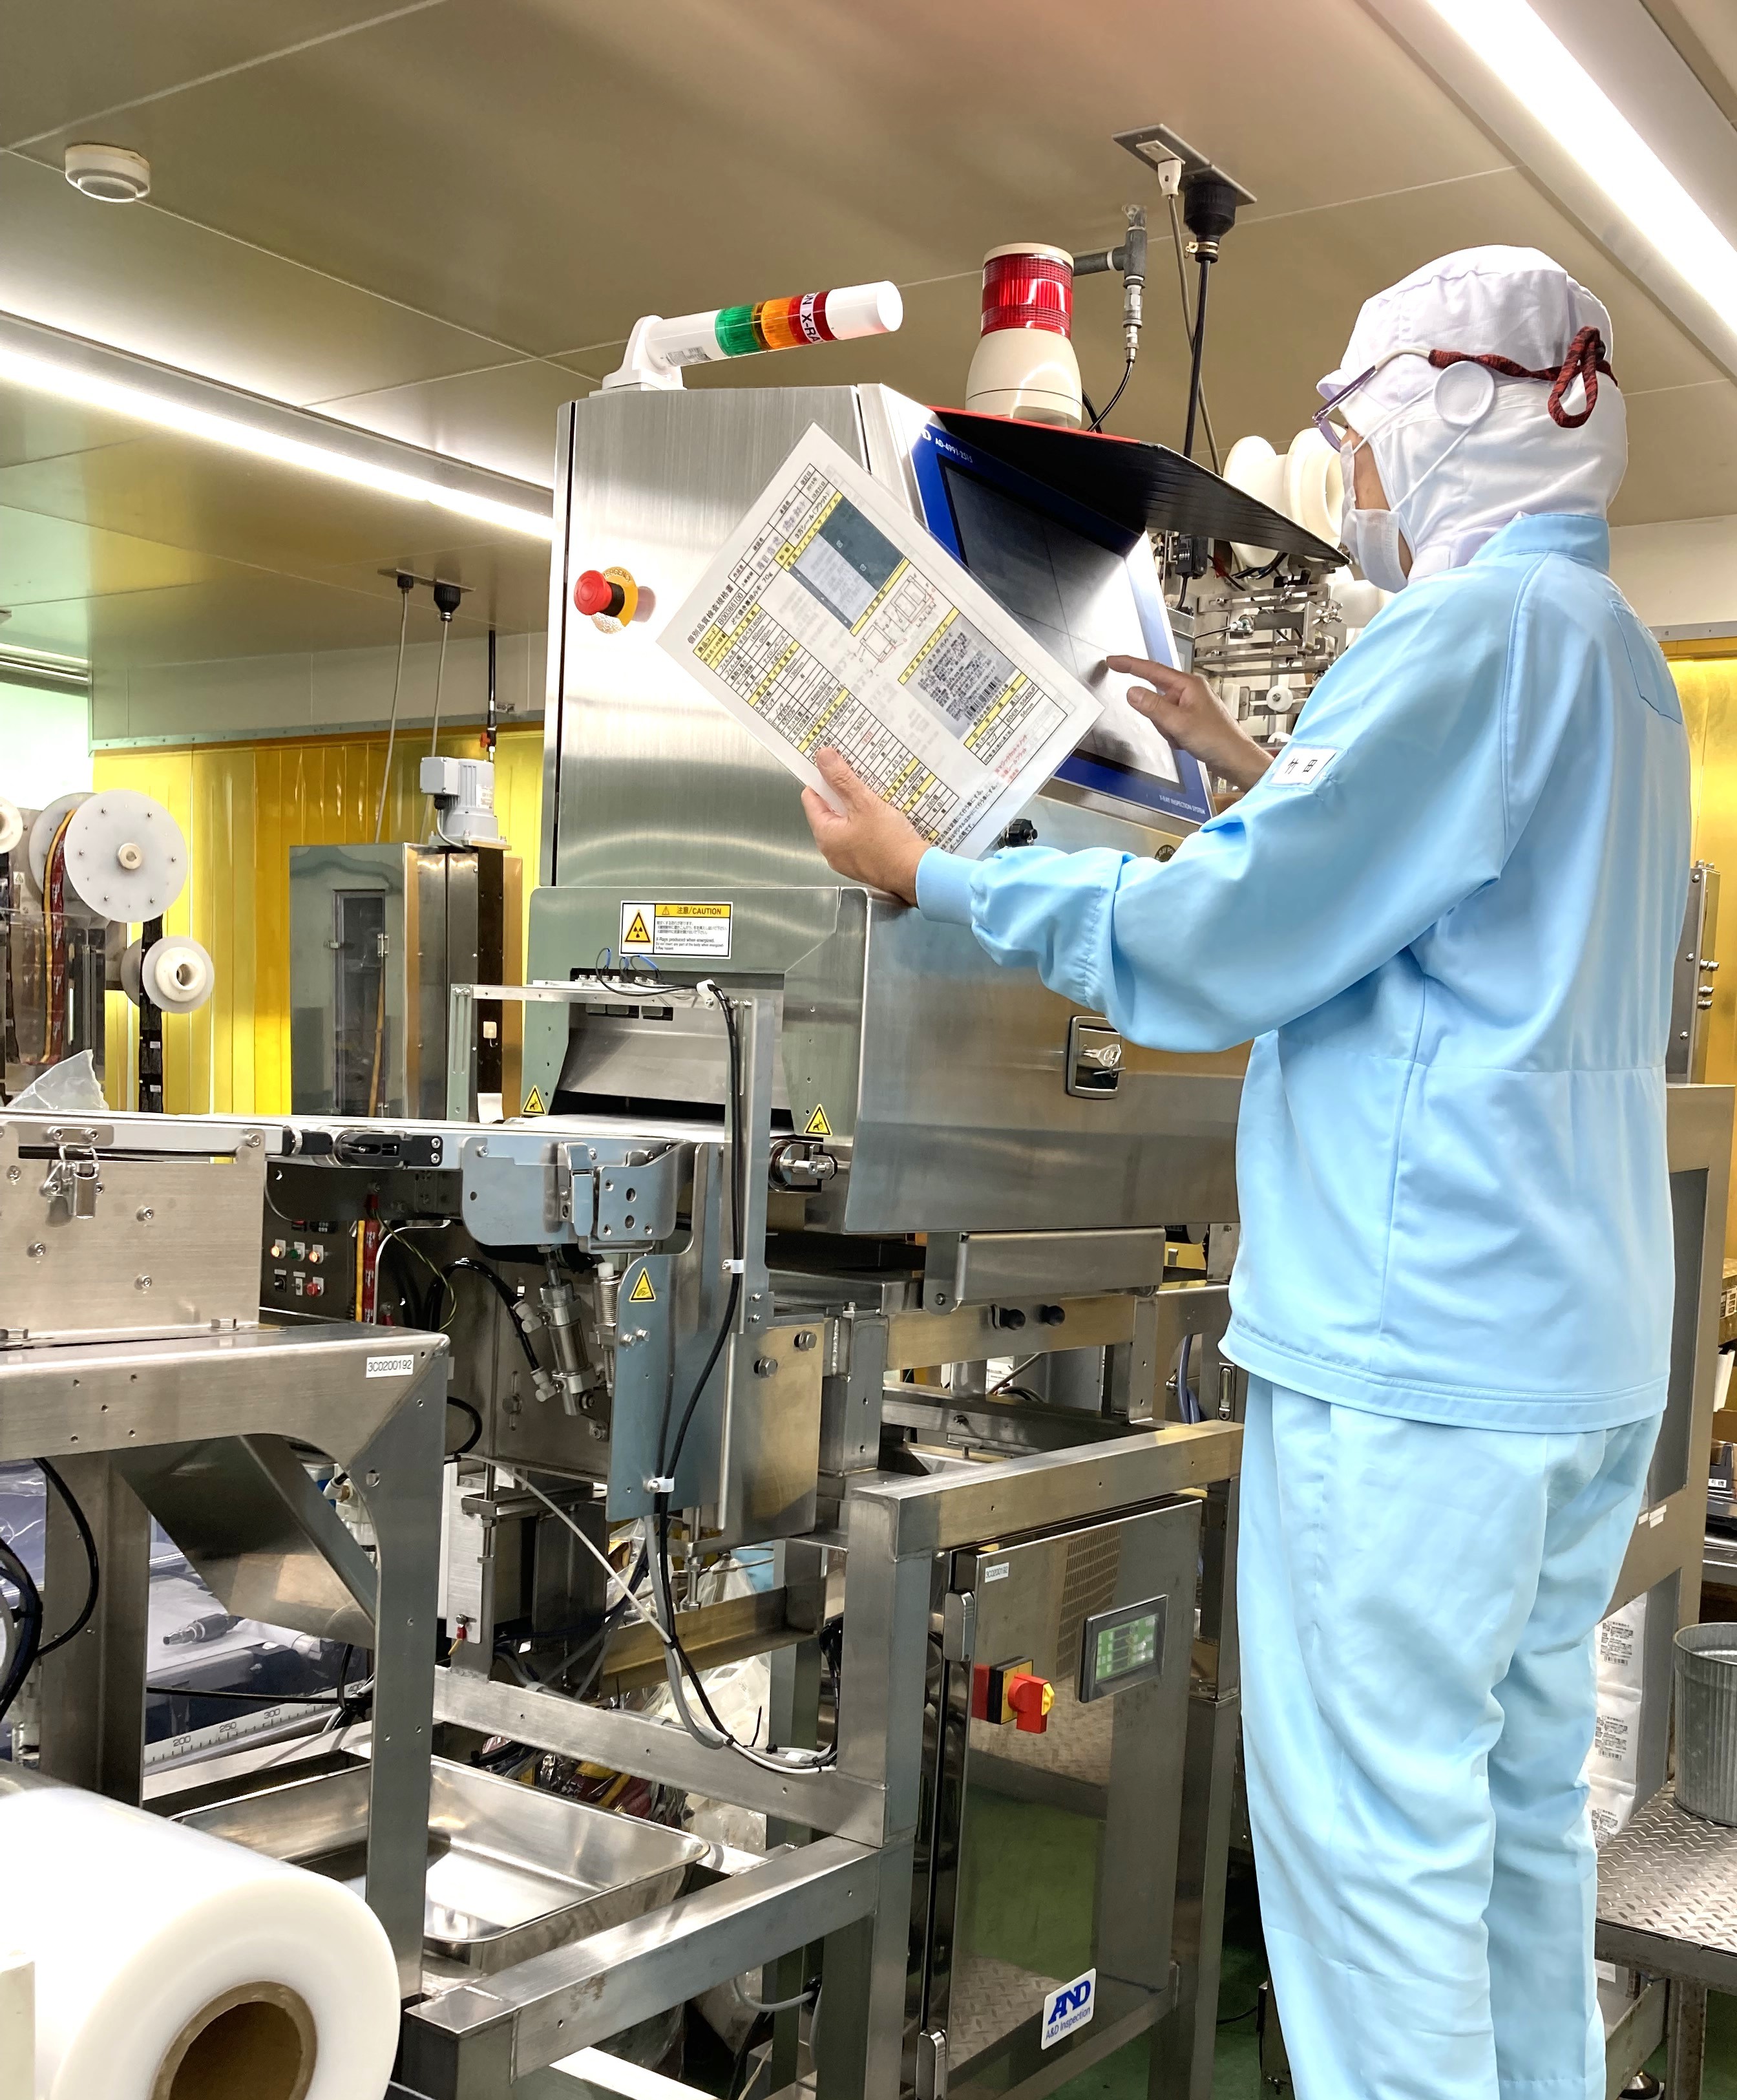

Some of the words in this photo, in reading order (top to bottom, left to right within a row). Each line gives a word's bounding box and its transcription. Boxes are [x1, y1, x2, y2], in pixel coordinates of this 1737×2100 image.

[801, 313, 822, 344] X-RA
[794, 491, 831, 540] 3方シール(フラット)
[785, 496, 840, 567] 使用フィルムサンプル
[604, 568, 631, 582] ERGENCY
[730, 584, 763, 626] どて焼き専用みそ
[761, 571, 774, 584] 70g
[686, 583, 735, 644] 個別品質検査規格書
[717, 592, 744, 625] B00366100
[696, 627, 717, 653] 商品コード
[762, 634, 786, 664] ナイロンベース
[719, 649, 736, 670] フィルム名
[783, 656, 798, 673] 80mm
[788, 661, 805, 679] 130mm
[748, 677, 763, 694] メーカー
[1019, 701, 1035, 718] 56mm
[985, 732, 998, 747] テープ
[677, 906, 721, 915] 注意/CAUTION
[368, 1359, 412, 1372] 3C0200192
[264, 1708, 280, 1719] 300
[219, 1721, 237, 1733] 250
[173, 1735, 191, 1746] 200
[1045, 2024, 1059, 2041] A&D
[1060, 2007, 1091, 2032] Inspection
